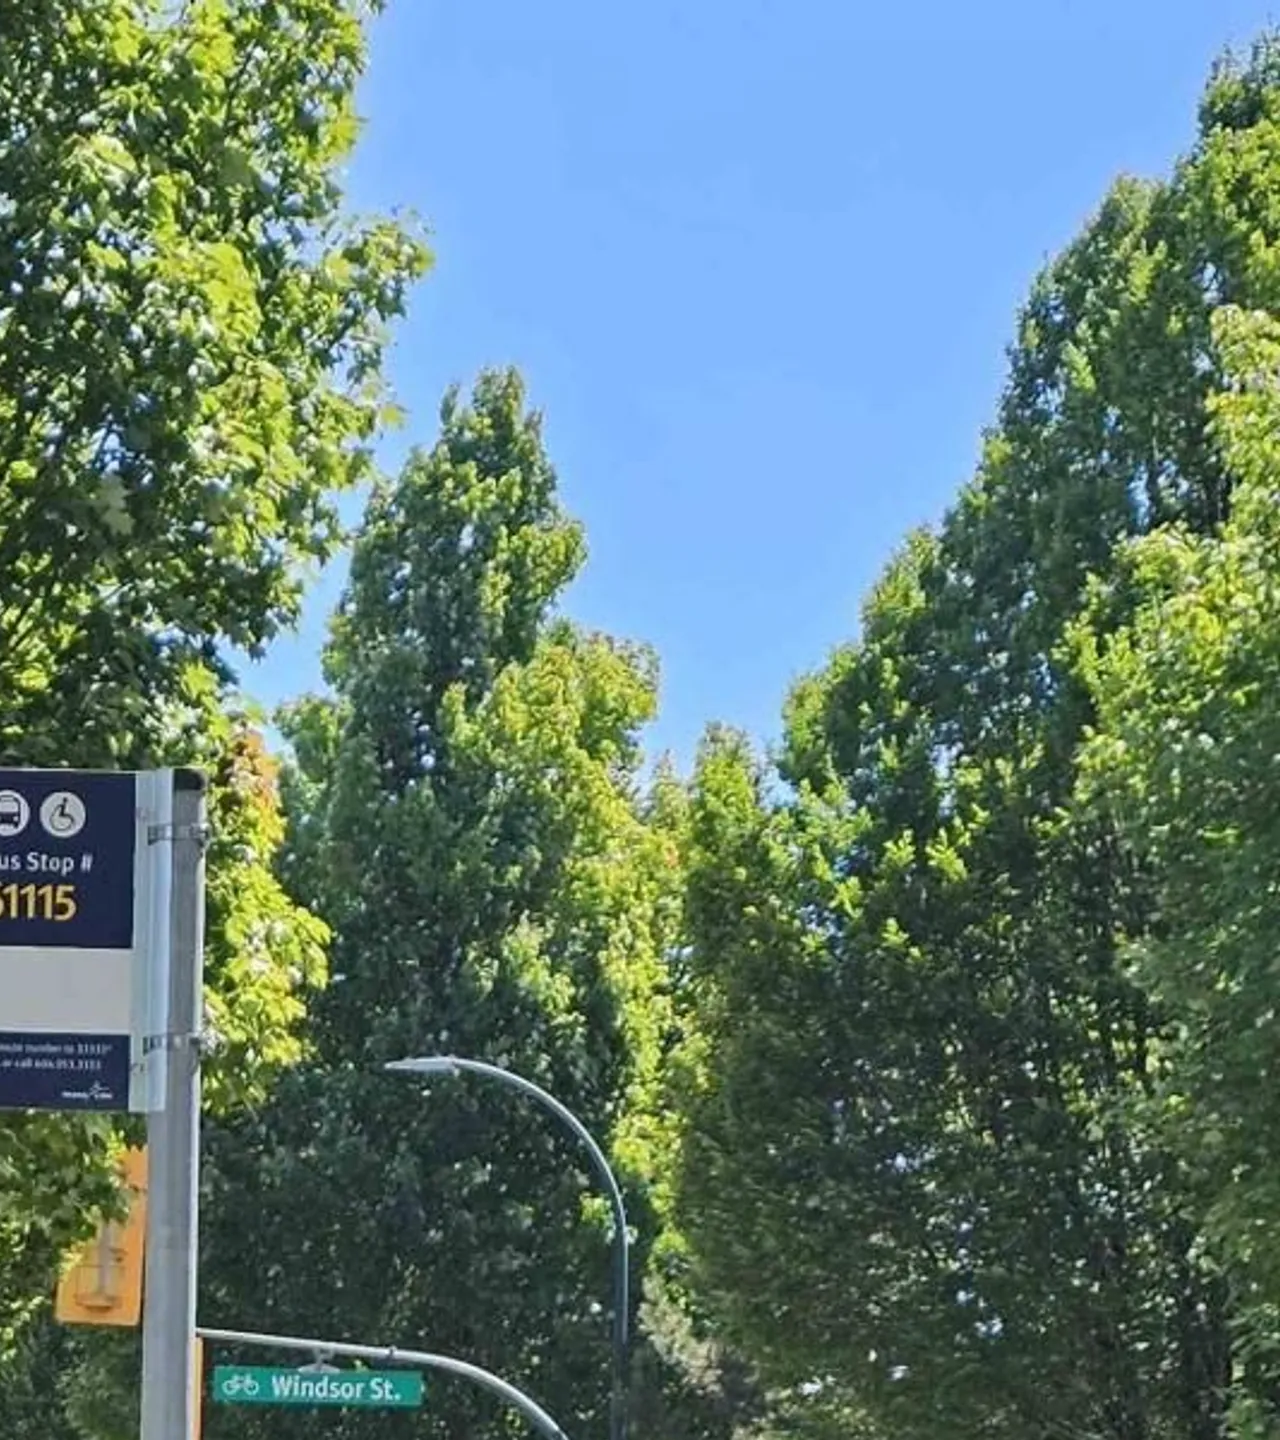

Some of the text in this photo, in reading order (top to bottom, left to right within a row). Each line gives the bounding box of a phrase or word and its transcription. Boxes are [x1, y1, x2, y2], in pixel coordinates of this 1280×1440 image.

[26, 851, 75, 877] Stop
[272, 1374, 402, 1401] Windsor St.
